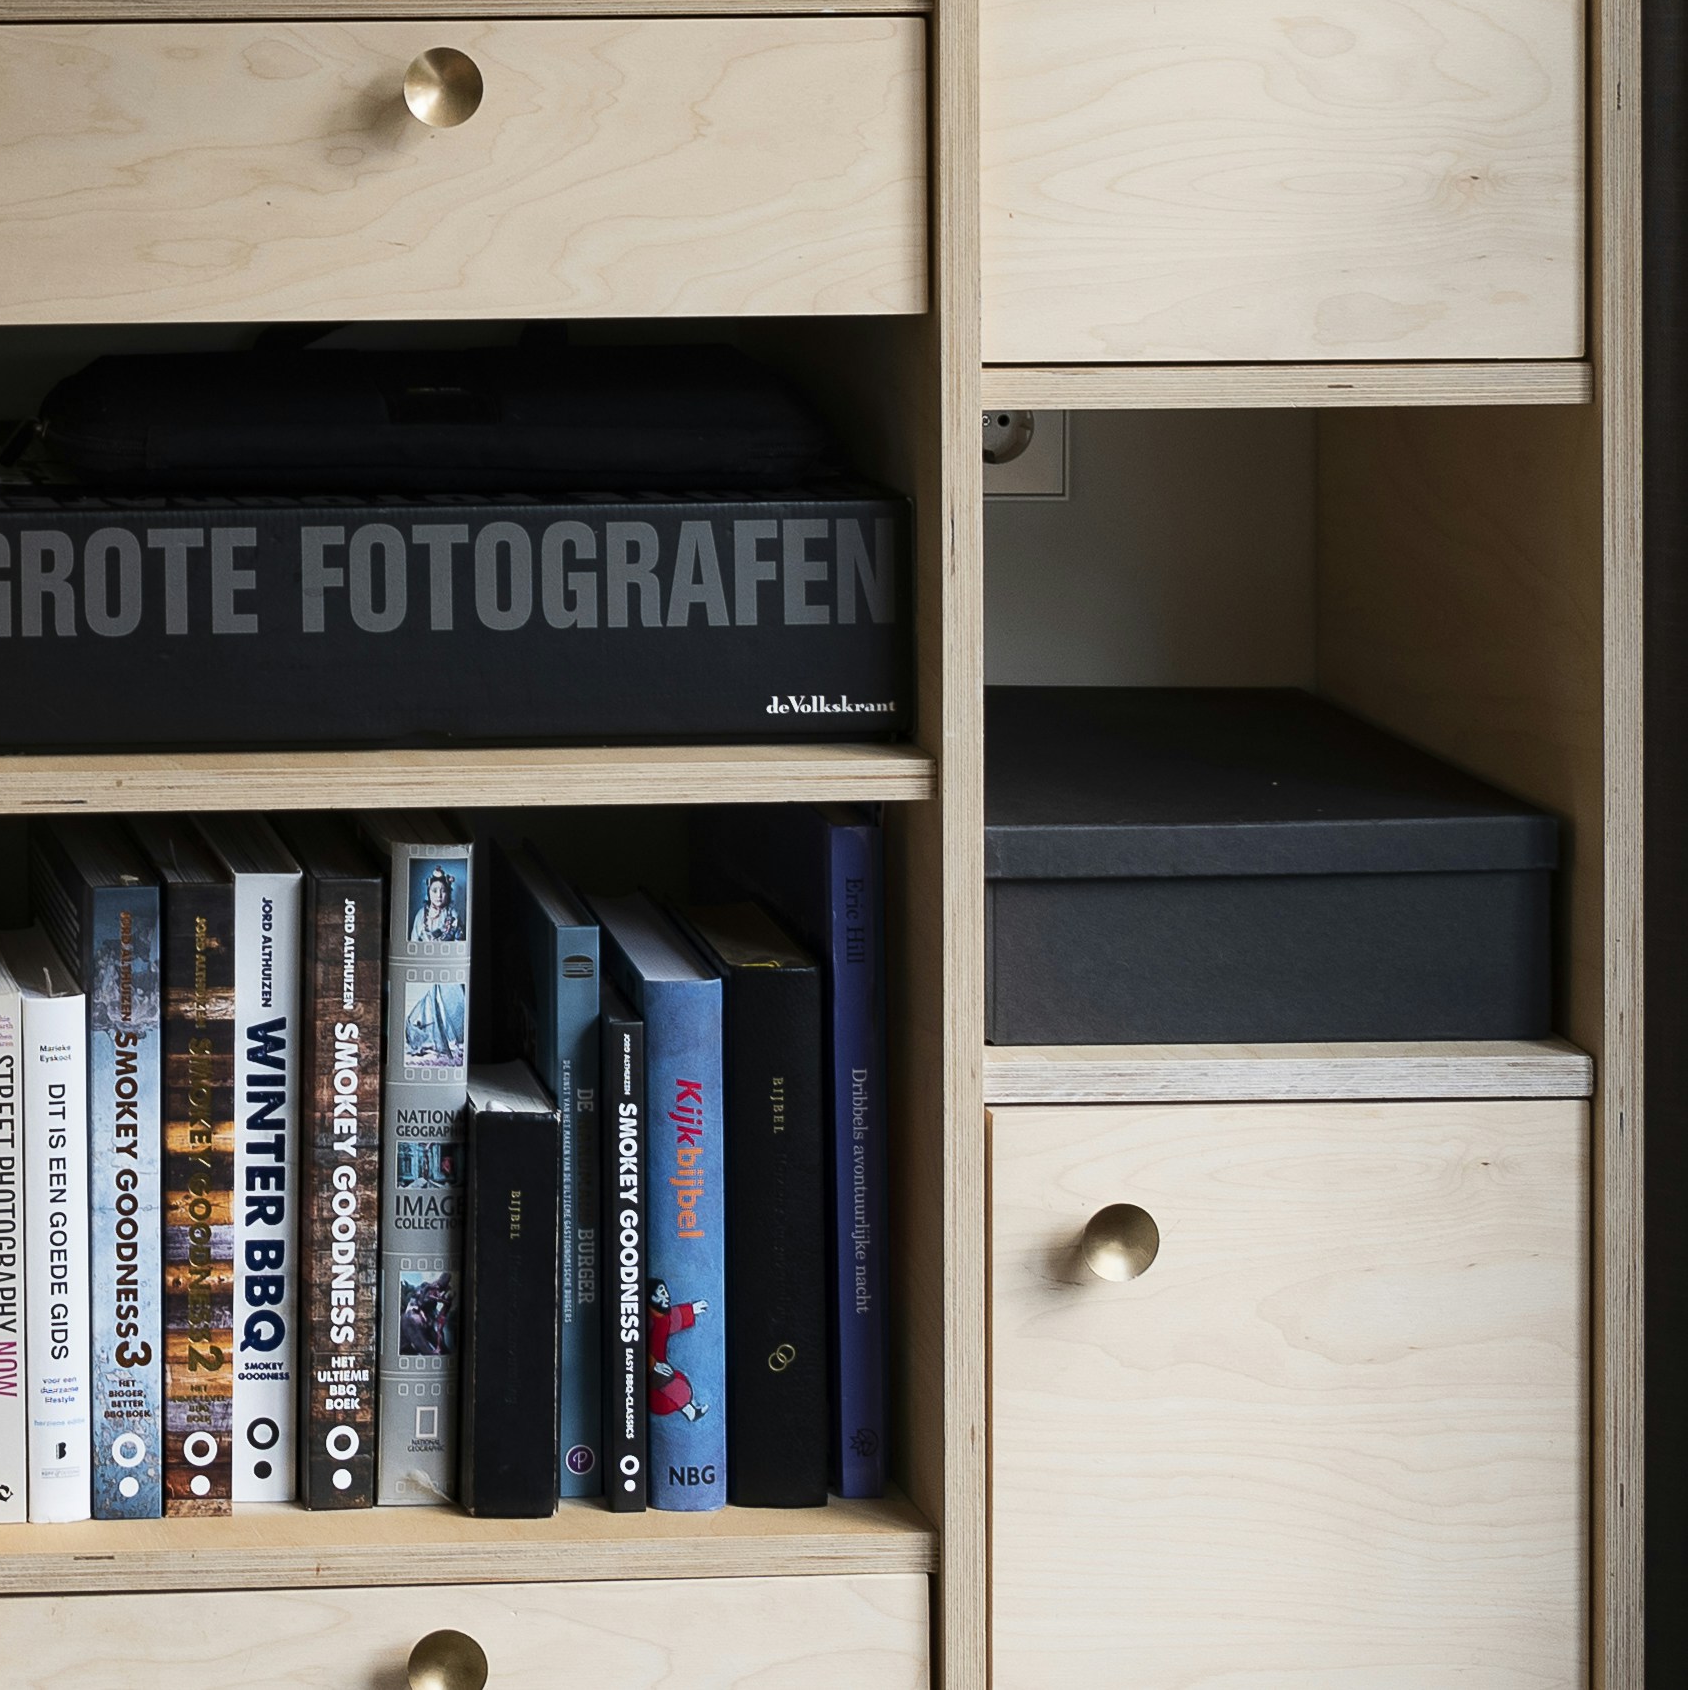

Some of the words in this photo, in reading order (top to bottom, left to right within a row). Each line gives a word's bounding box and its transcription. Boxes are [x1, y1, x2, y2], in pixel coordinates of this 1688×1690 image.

[301, 515, 896, 634] FOTOGRAFEN
[765, 695, 896, 715] deVolkskrant
[261, 896, 273, 932] JORD
[343, 897, 356, 934] JORD
[845, 877, 865, 921] Eric
[195, 916, 207, 951] JORD
[846, 926, 865, 965] Hill
[261, 934, 273, 1008] ALTHUIZEN
[342, 935, 356, 1011] ALTHUIZEN
[195, 953, 207, 1029] ALTHUIZEN
[39, 1044, 71, 1052] Marieke
[562, 1060, 571, 1070] DE
[48, 1084, 66, 1118] DIT
[114, 1030, 139, 1160] SMOKEY
[333, 1021, 359, 1158] SMOKEY
[562, 1071, 571, 1096] KUNST
[577, 1088, 595, 1112] DE
[188, 1037, 213, 1168] SMOKEY
[562, 1097, 571, 1112] VAN
[562, 1113, 571, 1128] HET
[770, 1076, 785, 1134] BIJBEL
[850, 1067, 869, 1141] Dribbels
[48, 1128, 66, 1150] IS
[246, 1016, 287, 1227] WINTER
[562, 1130, 571, 1155] MAKEN
[618, 1102, 639, 1204] SMOKEY
[667, 1078, 705, 1239] Kijkbijbel
[49, 1158, 67, 1204] EEN
[562, 1156, 571, 1171] VAN
[563, 1172, 571, 1183] DE
[510, 1190, 521, 1240] BIJBEL
[563, 1184, 572, 1218] ULTIEME
[851, 1144, 871, 1261] avontuurlijke
[49, 1211, 68, 1295] GOEDE
[114, 1168, 140, 1338] GOODNESS
[187, 1172, 213, 1349] GOODNESS
[330, 1164, 357, 1345] GOODNESS
[563, 1219, 572, 1288] GASTRONOMISCHE
[577, 1228, 595, 1304] BURGER
[619, 1209, 640, 1343] GOODNESS
[854, 1263, 872, 1314] nacht
[240, 1239, 286, 1352] BBQ
[563, 1289, 572, 1323] BURGERS
[50, 1302, 70, 1360] GIDS
[115, 1340, 153, 1369] 3
[187, 1345, 224, 1373] 2
[244, 1362, 284, 1371] SMOKEY
[330, 1356, 355, 1369] HET
[625, 1347, 634, 1372] EASY
[108, 1389, 147, 1398] BIGGER,
[237, 1372, 290, 1381] GOODNESS
[317, 1369, 370, 1383] ULTIEME
[328, 1384, 357, 1397] BBQ
[111, 1400, 144, 1408] BETTER
[325, 1398, 361, 1410] BOEK
[668, 1465, 715, 1487] NBG
